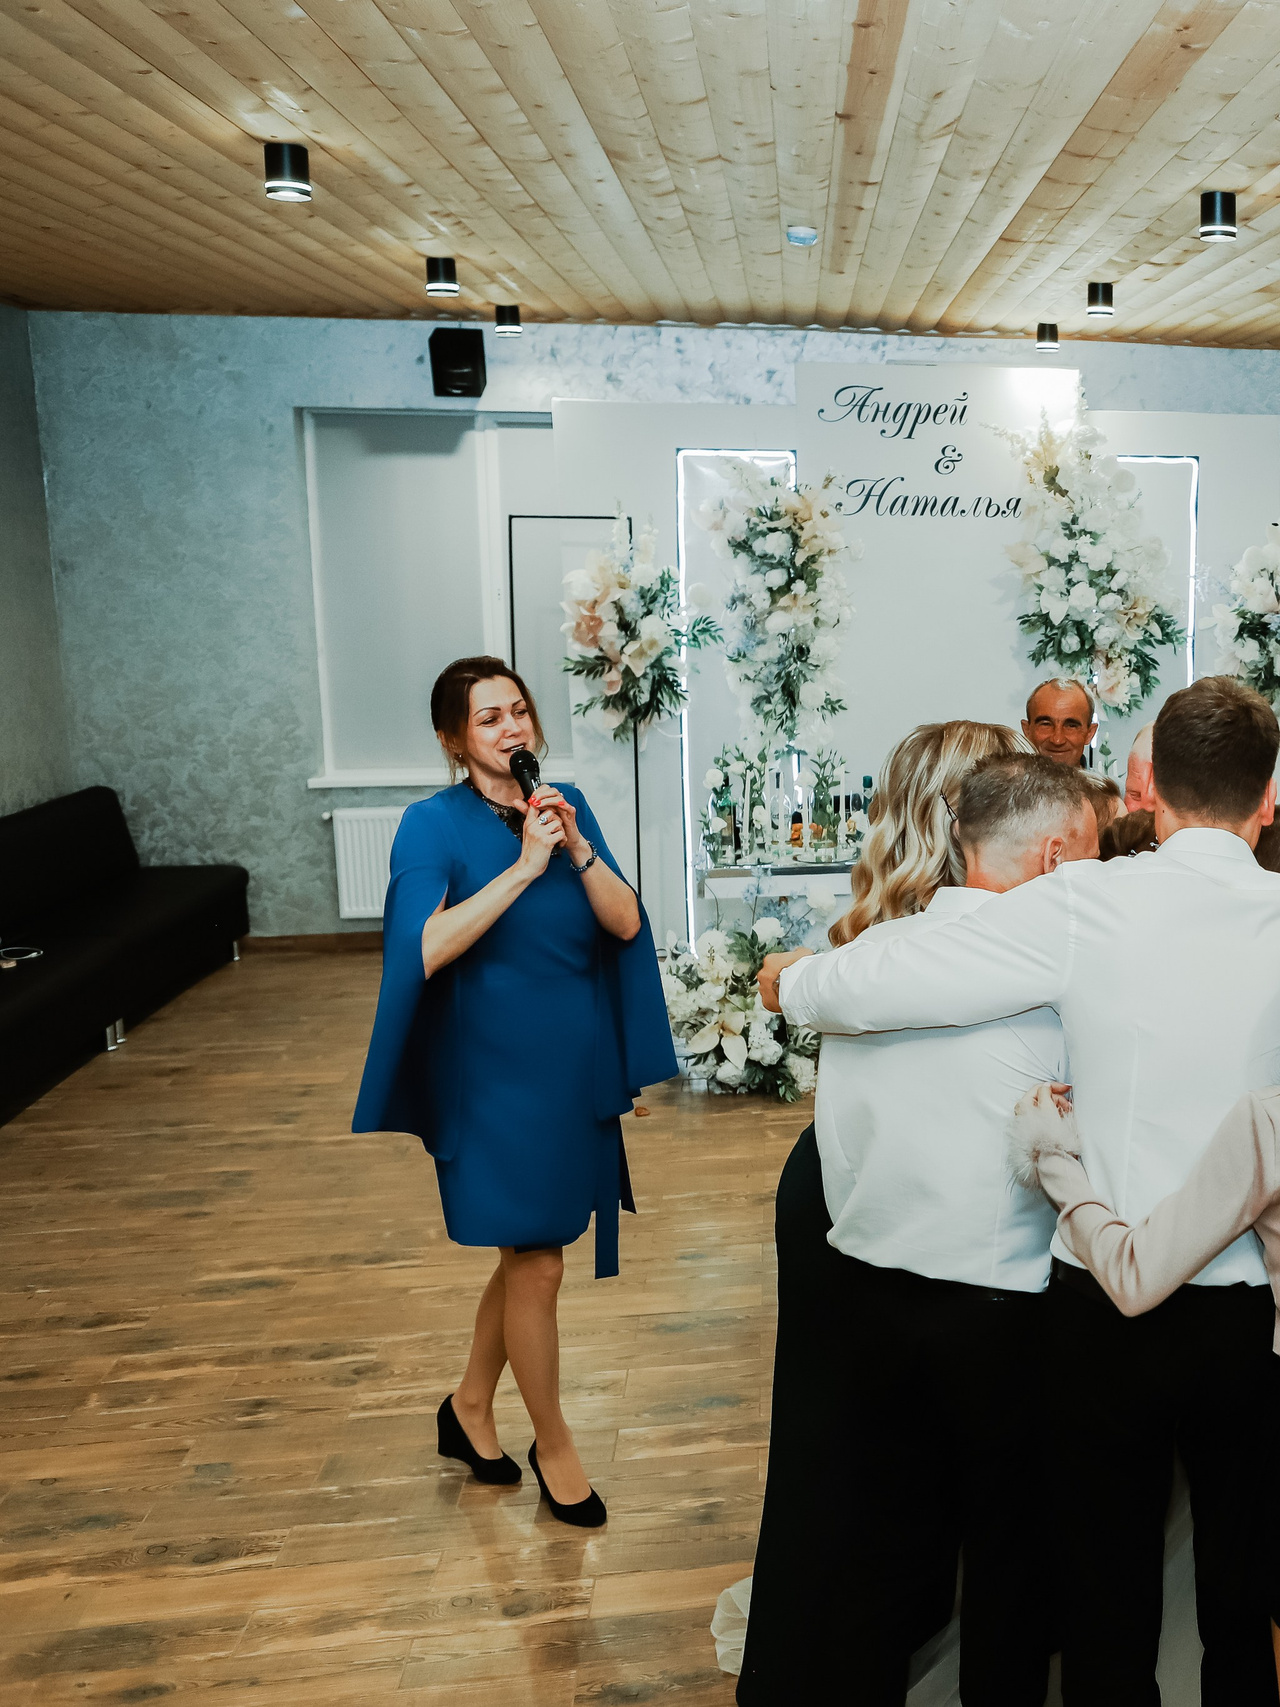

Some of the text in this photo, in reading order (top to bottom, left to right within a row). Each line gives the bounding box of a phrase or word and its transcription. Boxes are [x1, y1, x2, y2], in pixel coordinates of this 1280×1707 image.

[817, 385, 969, 440] Андрей
[934, 445, 963, 475] &
[835, 476, 1022, 519] Наталья
